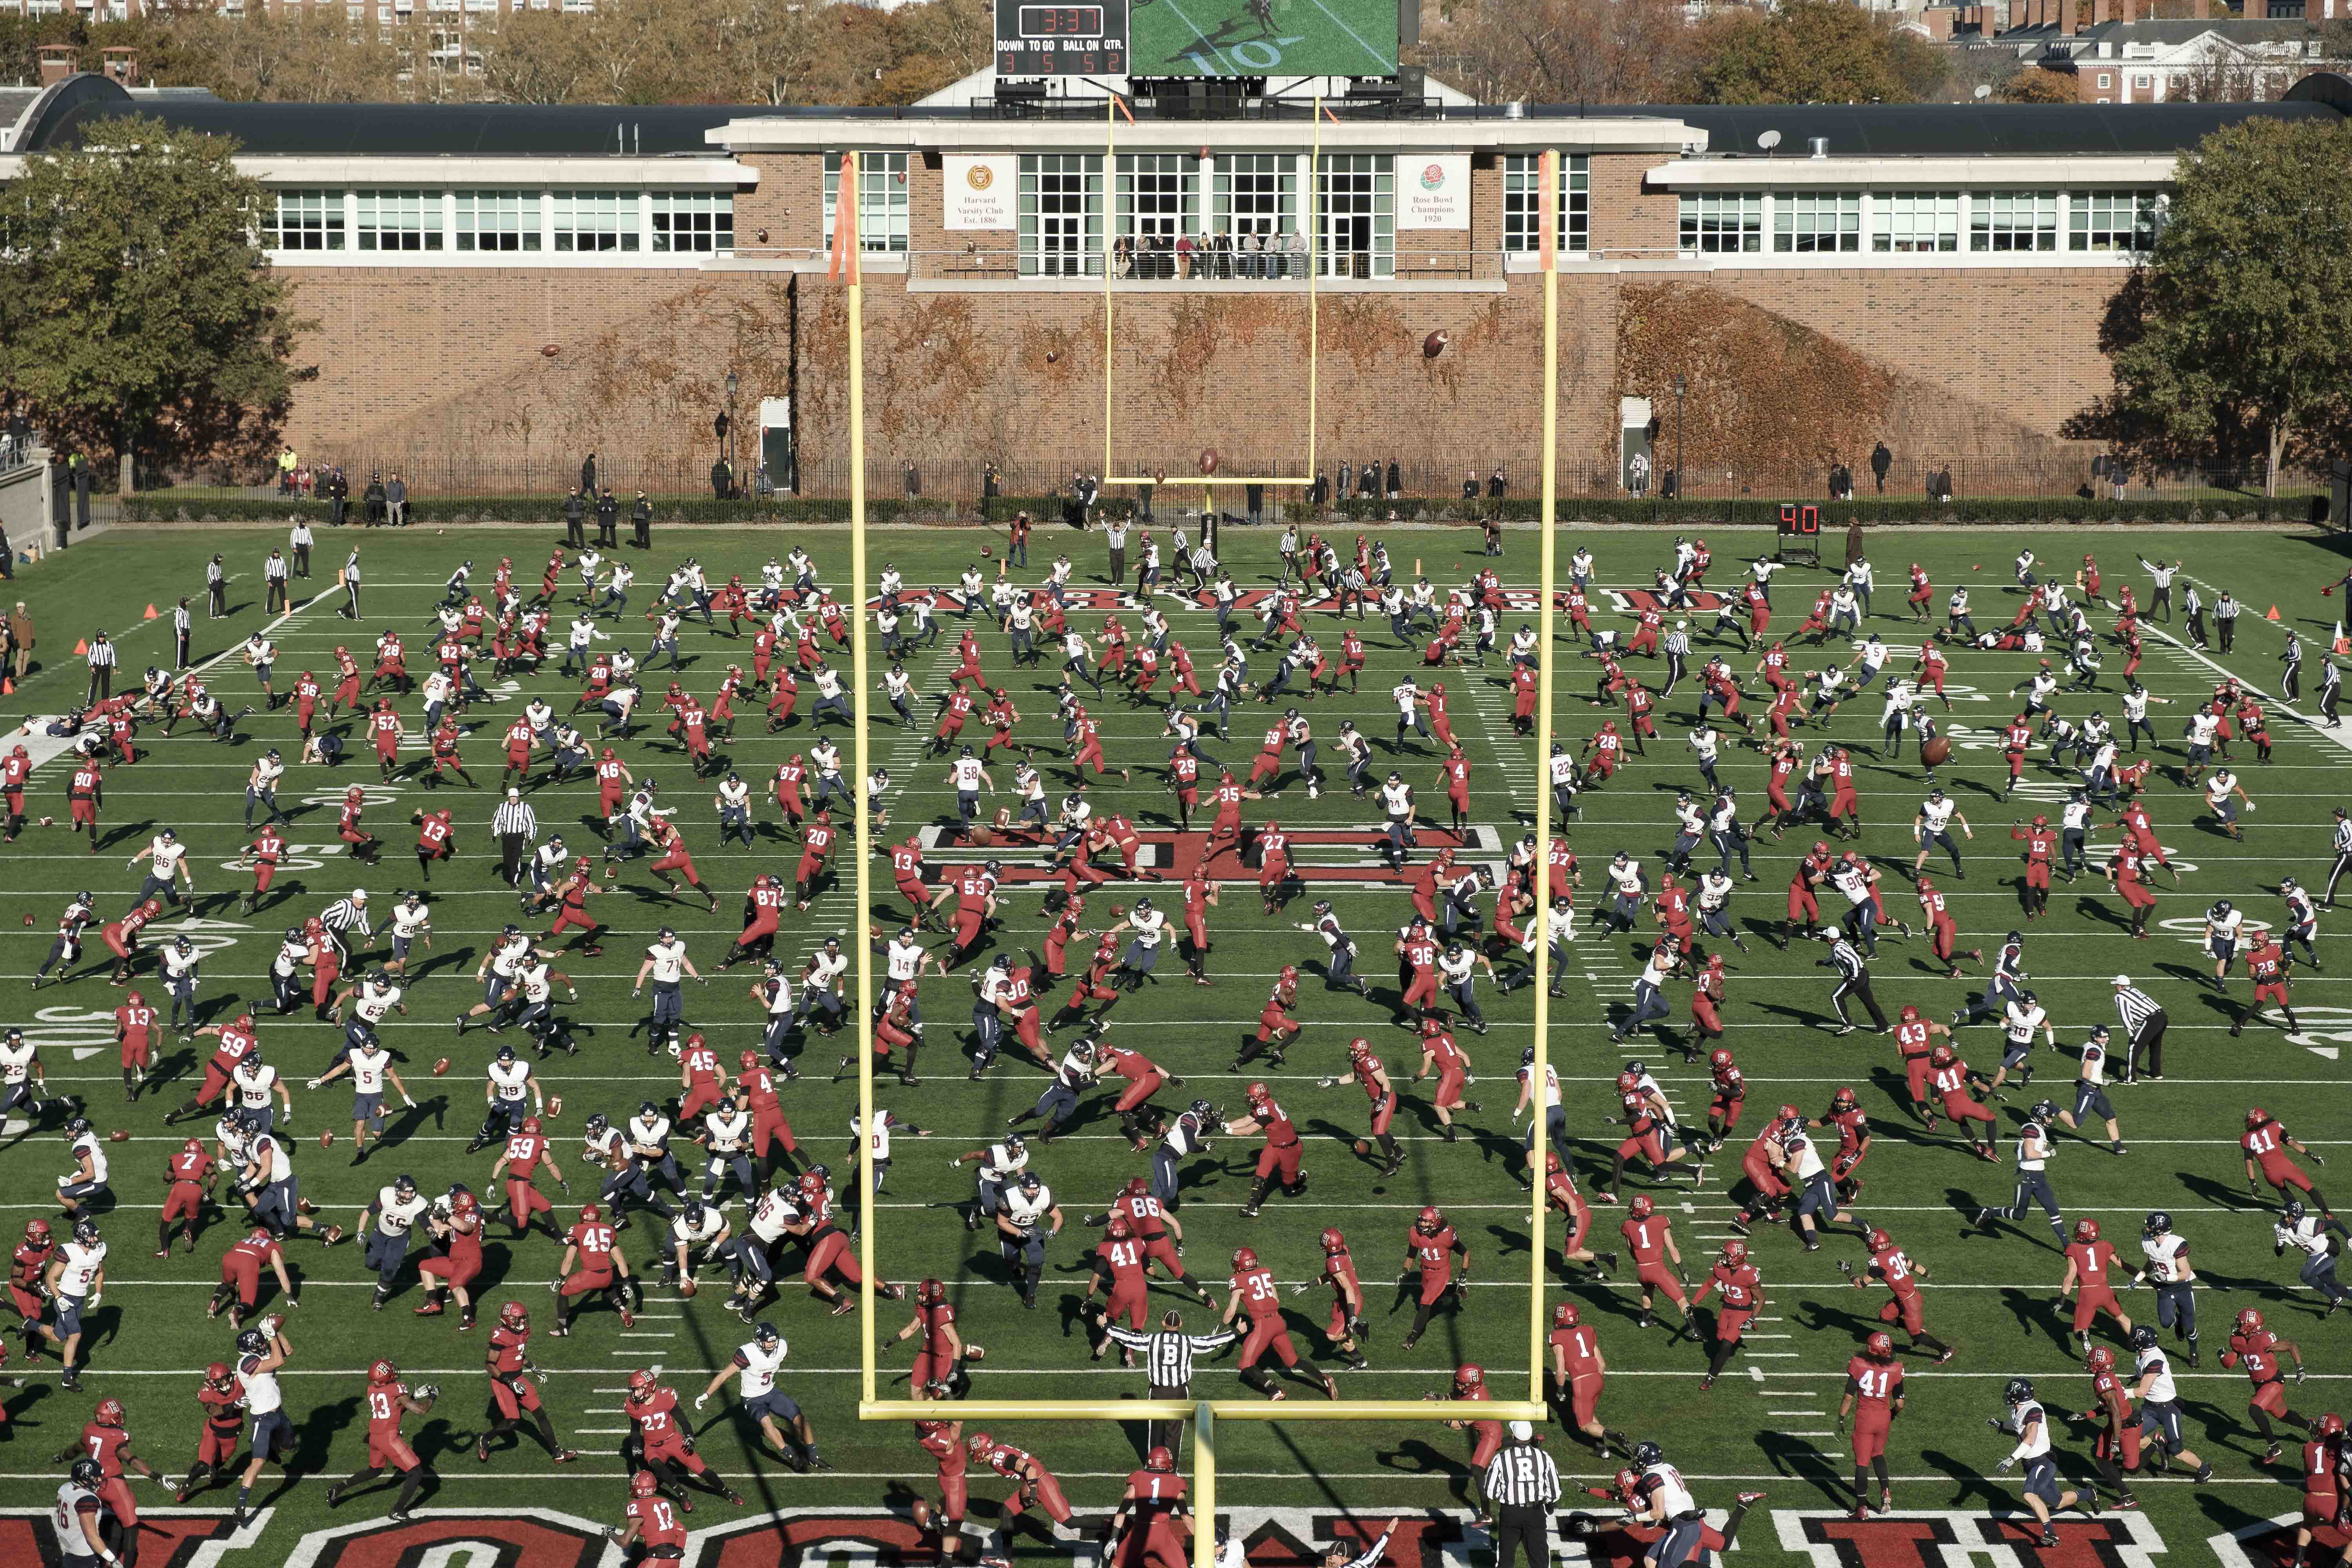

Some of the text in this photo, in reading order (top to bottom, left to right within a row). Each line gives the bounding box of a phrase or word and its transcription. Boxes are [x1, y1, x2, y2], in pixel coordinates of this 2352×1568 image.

[1045, 9, 1097, 31] 3:37
[997, 40, 1024, 51] DOWN
[1029, 40, 1054, 51] TO GO
[1063, 40, 1099, 51] BALL ON
[1104, 40, 1123, 50] QTR.
[1005, 54, 1014, 72] 3
[1043, 54, 1053, 72] 5
[1084, 54, 1094, 72] 5
[1109, 53, 1119, 72] 2
[958, 207, 982, 215] Varsity
[1411, 206, 1455, 214] Champions
[1781, 507, 1817, 532] 40
[1699, 554, 1709, 563] 17
[1484, 577, 1497, 588] 28
[1570, 595, 1584, 606] 28
[1751, 591, 1764, 600] 61
[468, 606, 482, 616] 82
[821, 605, 836, 617] 83
[1284, 601, 1293, 612] 13
[1450, 605, 1463, 616] 28
[1816, 602, 1825, 612] 17
[1646, 612, 1659, 624] 72
[757, 635, 765, 646] 4
[1074, 637, 1082, 648] 49
[2340, 641, 2348, 651] 10
[383, 645, 399, 658] 28
[442, 646, 457, 659] 82
[971, 644, 976, 656] 4
[1351, 642, 1361, 653] 12
[1874, 648, 1879, 657] 5
[1143, 650, 1155, 663] 47
[1768, 653, 1783, 666] 45
[592, 667, 607, 678] 20
[1522, 673, 1530, 681] 4
[301, 683, 317, 697] 36
[1399, 688, 1412, 699] 25
[954, 697, 970, 711] 13
[1439, 699, 1443, 711] 1
[1634, 691, 1646, 706] 12
[1780, 693, 1786, 705] 1
[2133, 706, 2142, 714] 14
[378, 716, 395, 730] 52
[685, 711, 702, 725] 27
[511, 727, 529, 740] 46
[2013, 730, 2029, 743] 17
[2200, 728, 2211, 736] 20
[1600, 735, 1617, 750] 28
[9, 760, 19, 775] 3
[600, 763, 618, 778] 46
[1178, 759, 1195, 774] 29
[1455, 764, 1464, 778] 4
[1558, 762, 1568, 775] 22
[74, 773, 92, 787] 80
[780, 767, 799, 781] 87
[964, 767, 977, 780] 58
[1220, 788, 1238, 802] 35
[1116, 820, 1125, 829] 1
[2136, 815, 2147, 828] 4
[424, 822, 446, 841] 13
[808, 829, 827, 846] 20
[262, 839, 279, 853] 17
[1264, 835, 1284, 850] 27
[2033, 840, 2045, 852] 12
[155, 855, 169, 867] 86
[895, 853, 912, 870] 13
[1548, 852, 1569, 866] 87
[964, 880, 984, 895] 53
[757, 891, 777, 907] 87
[1675, 895, 1683, 911] 4
[1412, 947, 1432, 965] 36
[666, 960, 679, 973] 71
[897, 959, 908, 972] 14
[2258, 960, 2275, 973] 28
[525, 984, 541, 994] 22
[128, 1009, 148, 1025] 13
[366, 1006, 385, 1016] 63
[1901, 1024, 1926, 1044] 43
[220, 1032, 246, 1057] 59
[1443, 1038, 1454, 1056] 1
[690, 1052, 713, 1071] 45
[1369, 1060, 1378, 1069] 91
[5, 1065, 23, 1076] 22
[363, 1071, 372, 1083] 5
[1730, 1071, 1740, 1080] 26
[760, 1074, 772, 1093] 4
[1937, 1069, 1960, 1092] 41
[505, 1087, 518, 1095] 19
[1626, 1095, 1636, 1104] 26
[1257, 1107, 1268, 1115] 66
[1857, 1114, 1865, 1123] 41
[2250, 1129, 2274, 1154] 41
[509, 1138, 534, 1160] 59
[181, 1154, 196, 1169] 7
[1132, 1198, 1159, 1217] 86
[387, 1214, 407, 1228] 56
[465, 1214, 477, 1223] 50
[583, 1229, 610, 1252] 45
[1639, 1225, 1650, 1248] 1
[1111, 1242, 1137, 1267] 41
[1422, 1248, 1440, 1260] 41
[2087, 1247, 2098, 1271] 1
[1335, 1261, 1340, 1270] 1
[80, 1269, 89, 1283] 5
[1249, 1273, 1274, 1300] 35
[947, 1311, 952, 1319] 1
[1576, 1333, 1589, 1357] 1
[1163, 1345, 1177, 1364] B
[760, 1372, 772, 1385] 5
[1859, 1370, 1888, 1397] 41
[2100, 1378, 2111, 1389] 12
[370, 1393, 390, 1419] 13
[641, 1412, 665, 1430] 27
[90, 1436, 102, 1459] 7
[2315, 1446, 2323, 1473] 1
[1517, 1459, 1534, 1481] R
[1149, 1478, 1160, 1505] 1
[627, 1504, 637, 1515] 12
[653, 1502, 673, 1531] 12
